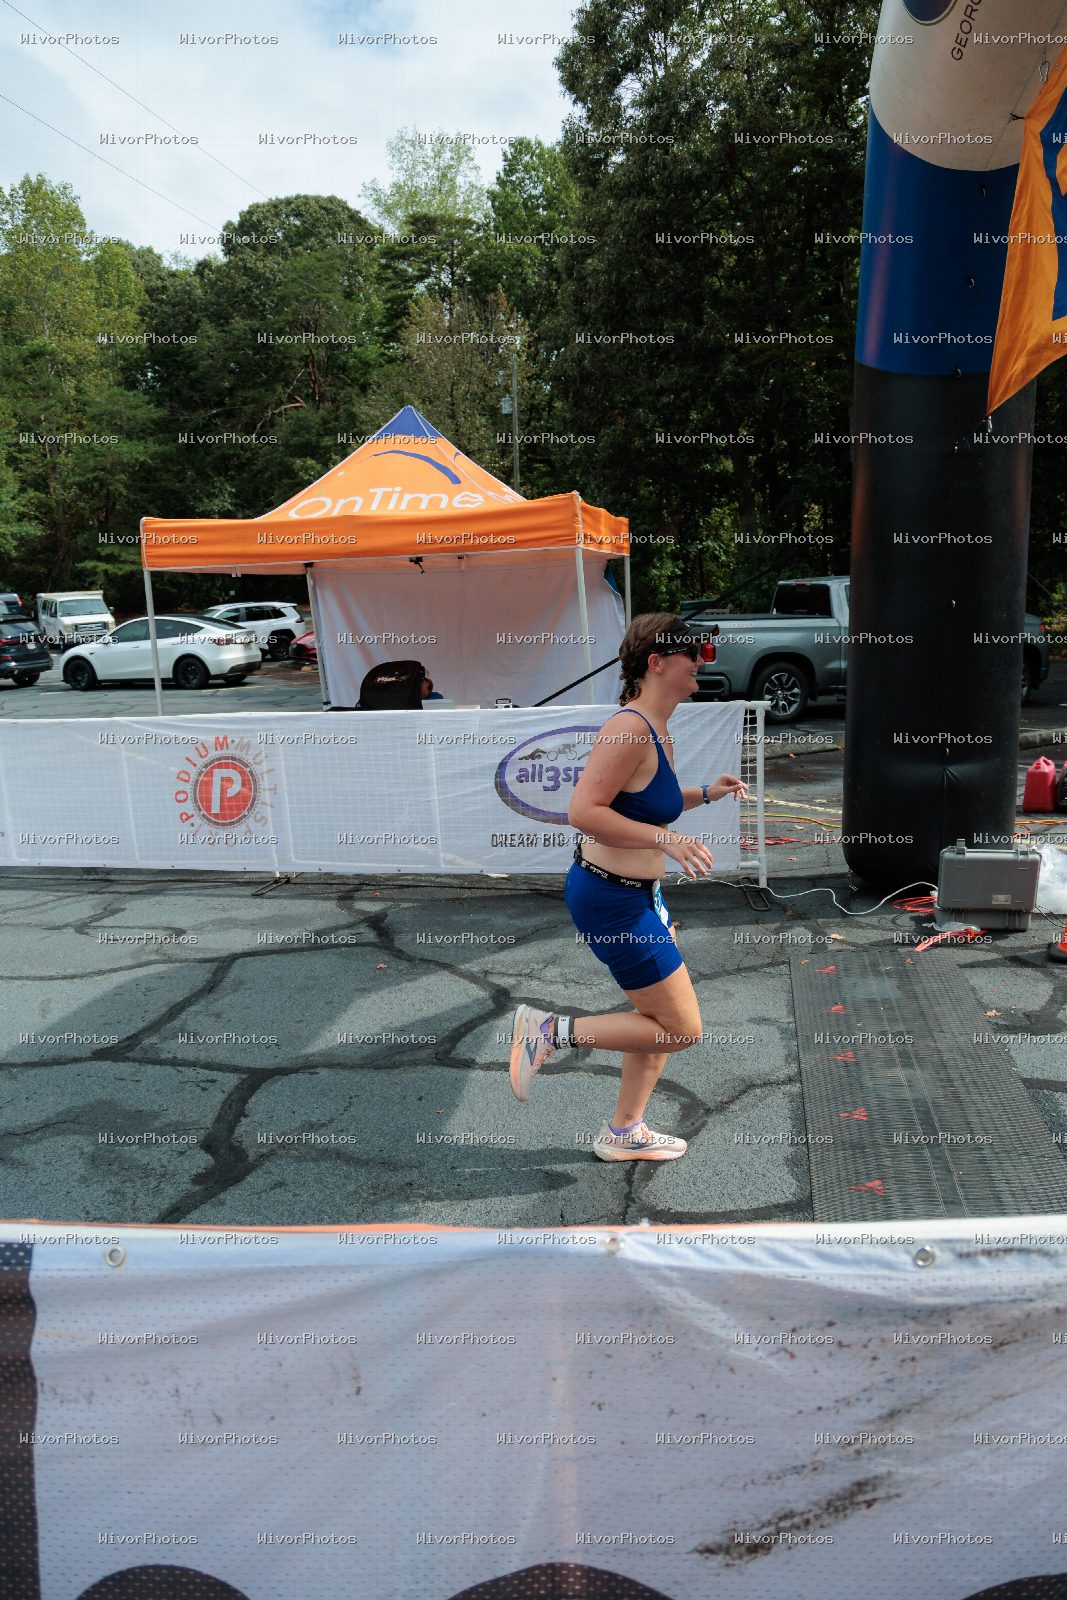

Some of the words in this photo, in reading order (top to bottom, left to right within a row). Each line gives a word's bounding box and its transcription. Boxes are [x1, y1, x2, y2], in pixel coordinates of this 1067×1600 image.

[288, 487, 484, 518] OnTime
[175, 735, 229, 824] PODIUM
[212, 769, 242, 813] P
